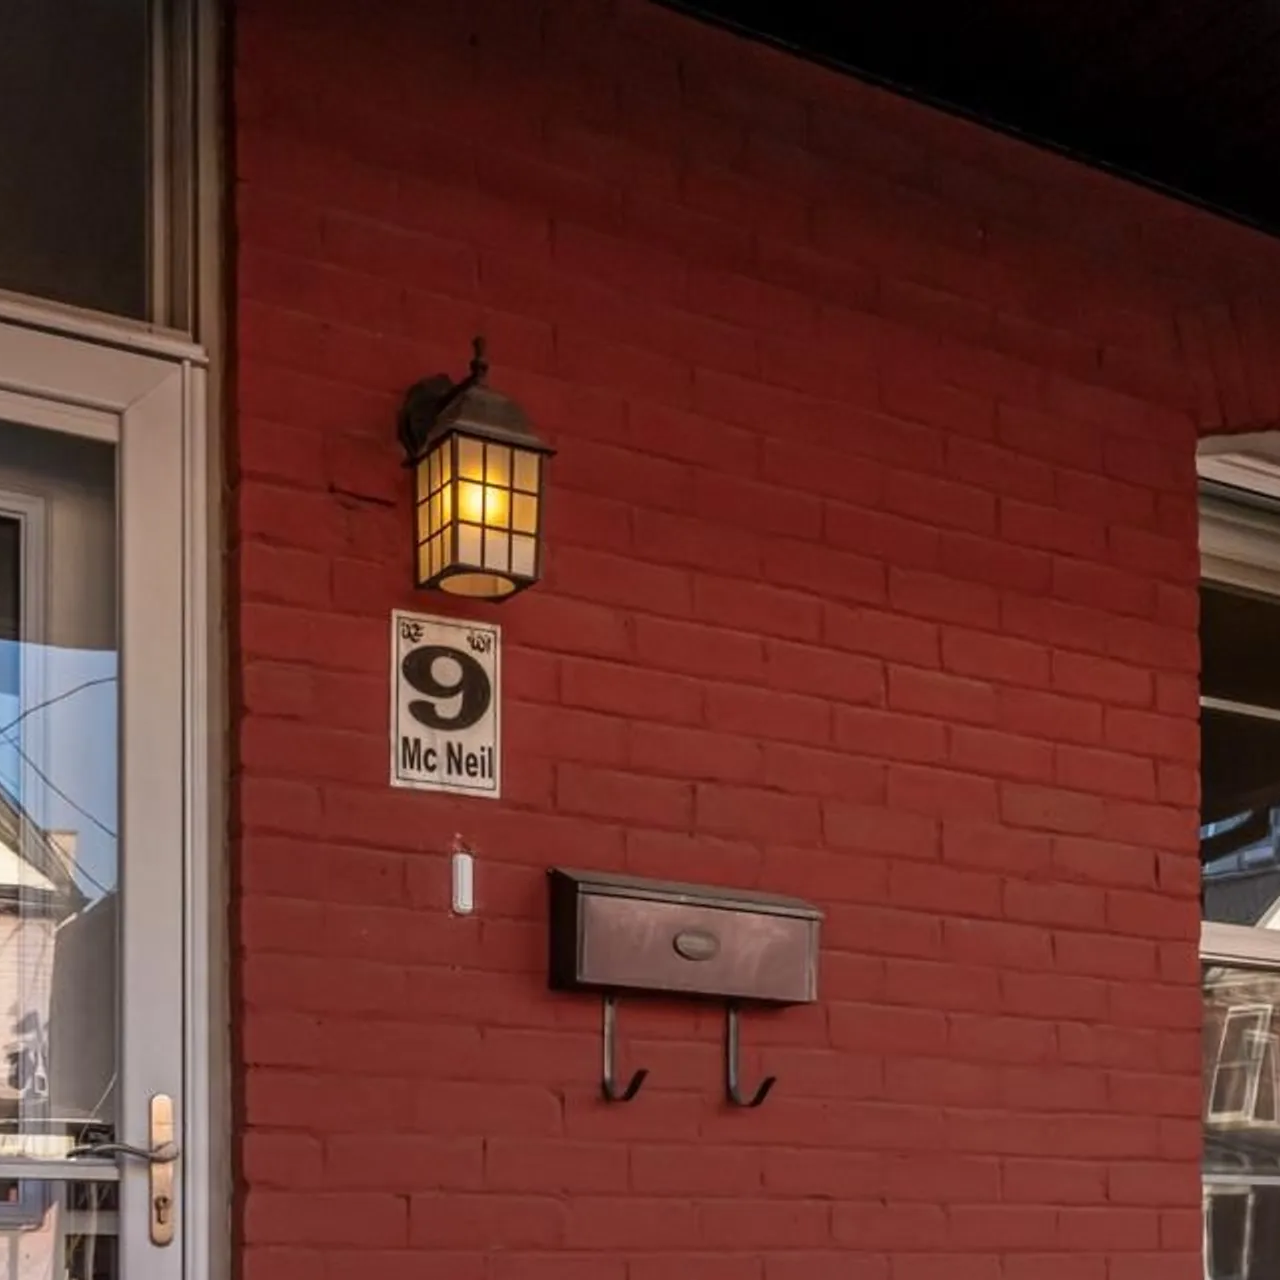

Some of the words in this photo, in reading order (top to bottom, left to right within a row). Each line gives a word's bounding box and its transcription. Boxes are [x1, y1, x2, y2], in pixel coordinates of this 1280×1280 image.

[401, 645, 491, 731] 9
[402, 736, 437, 773] Mc
[446, 741, 493, 779] Neil
